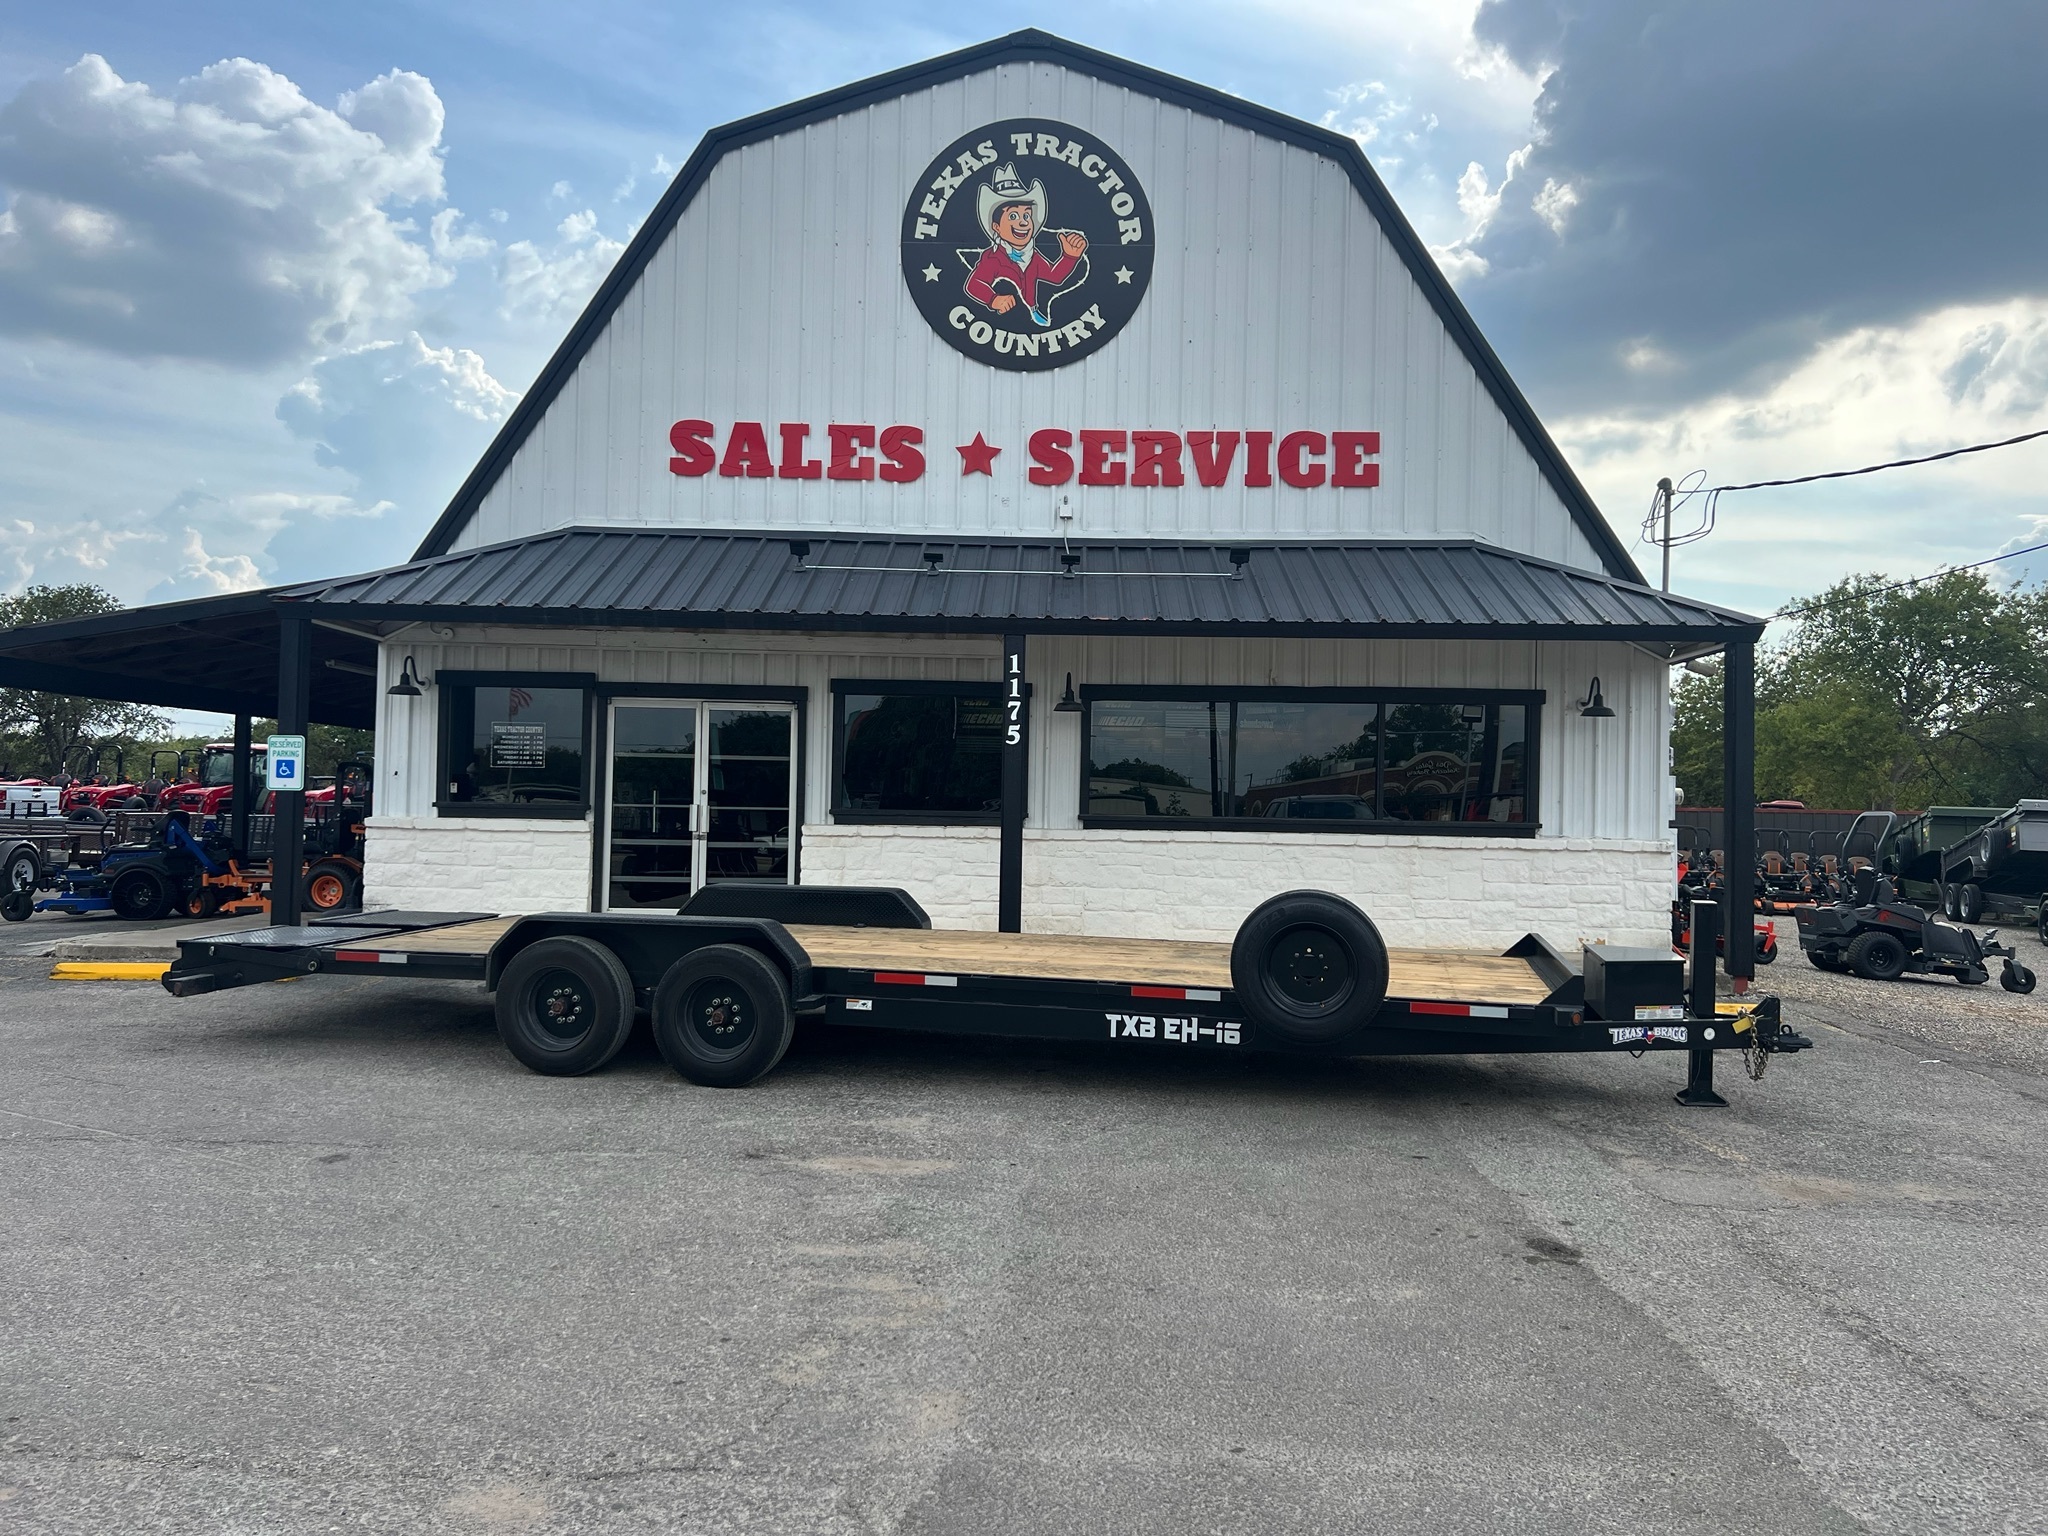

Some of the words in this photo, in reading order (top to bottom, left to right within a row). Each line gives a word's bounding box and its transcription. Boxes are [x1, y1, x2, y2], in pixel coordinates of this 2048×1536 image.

[914, 139, 998, 240] TEXAS
[1010, 132, 1142, 245] TRACTOR
[996, 180, 1021, 191] TEX
[948, 302, 1107, 357] COUNTRY
[669, 419, 926, 483] SALES
[1028, 428, 1381, 488] SERVICE
[1005, 653, 1021, 745] 1175
[270, 741, 302, 749] RESERVED
[1105, 1013, 1156, 1038] TXB
[1162, 1017, 1242, 1045] EH-16
[1609, 1027, 1643, 1044] TEXAS
[1653, 1026, 1687, 1042] BRAGG
